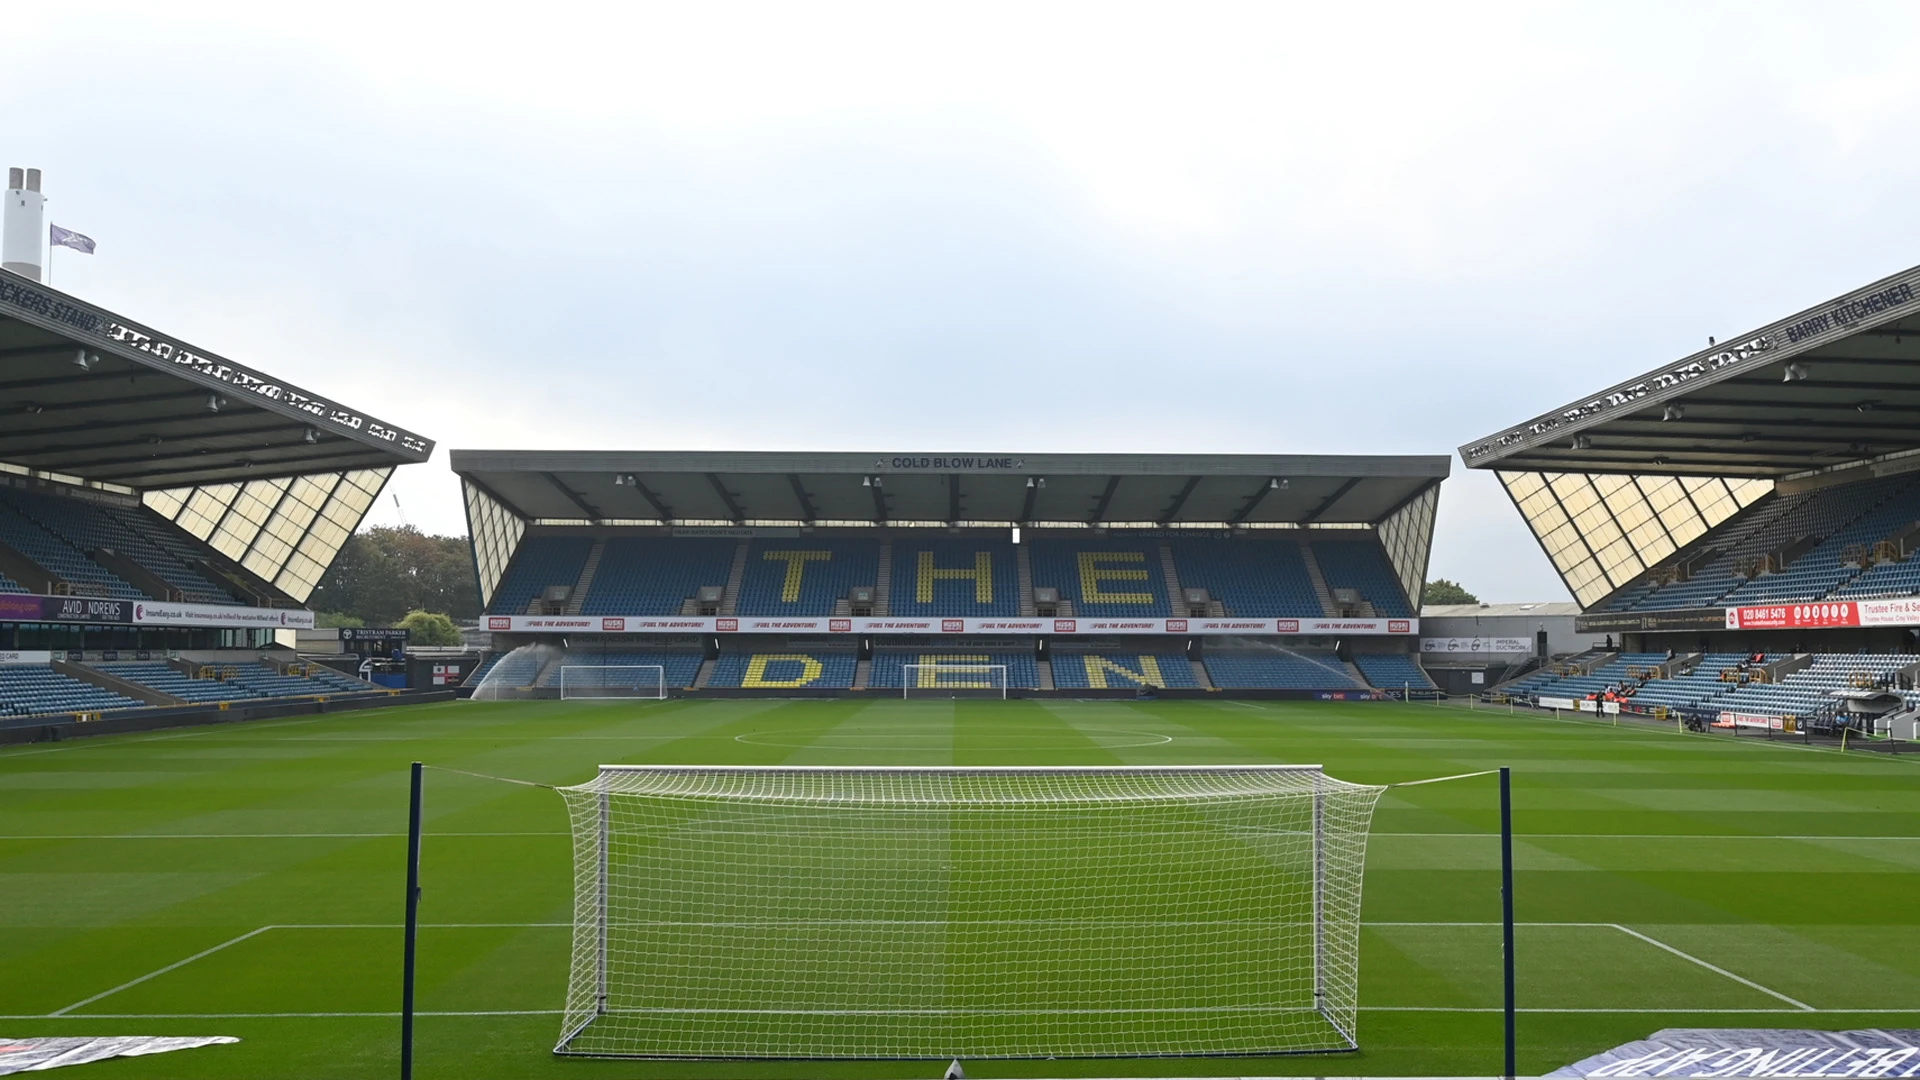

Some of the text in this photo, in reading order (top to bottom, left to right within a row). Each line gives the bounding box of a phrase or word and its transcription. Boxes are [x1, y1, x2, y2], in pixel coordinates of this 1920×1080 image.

[50, 301, 98, 331] STAND
[1785, 283, 1914, 342] BARRY KITCHENER
[892, 457, 1012, 469] COLD BLOW LANE
[763, 551, 1154, 604] THE
[146, 609, 182, 619] InsureEasy.co.uk
[1743, 609, 1755, 620] 020
[1755, 608, 1769, 619] 8461
[1770, 607, 1786, 619] 5476
[1864, 604, 1889, 614] Trustee
[1890, 603, 1903, 612] Fire
[1905, 602, 1910, 612] &
[572, 635, 598, 643] SHOW
[636, 635, 652, 643] THE
[673, 635, 699, 643] CARD
[741, 654, 1166, 689] DEN
[1586, 1047, 1732, 1078] APP
[1690, 1047, 1919, 1078] BETTING
